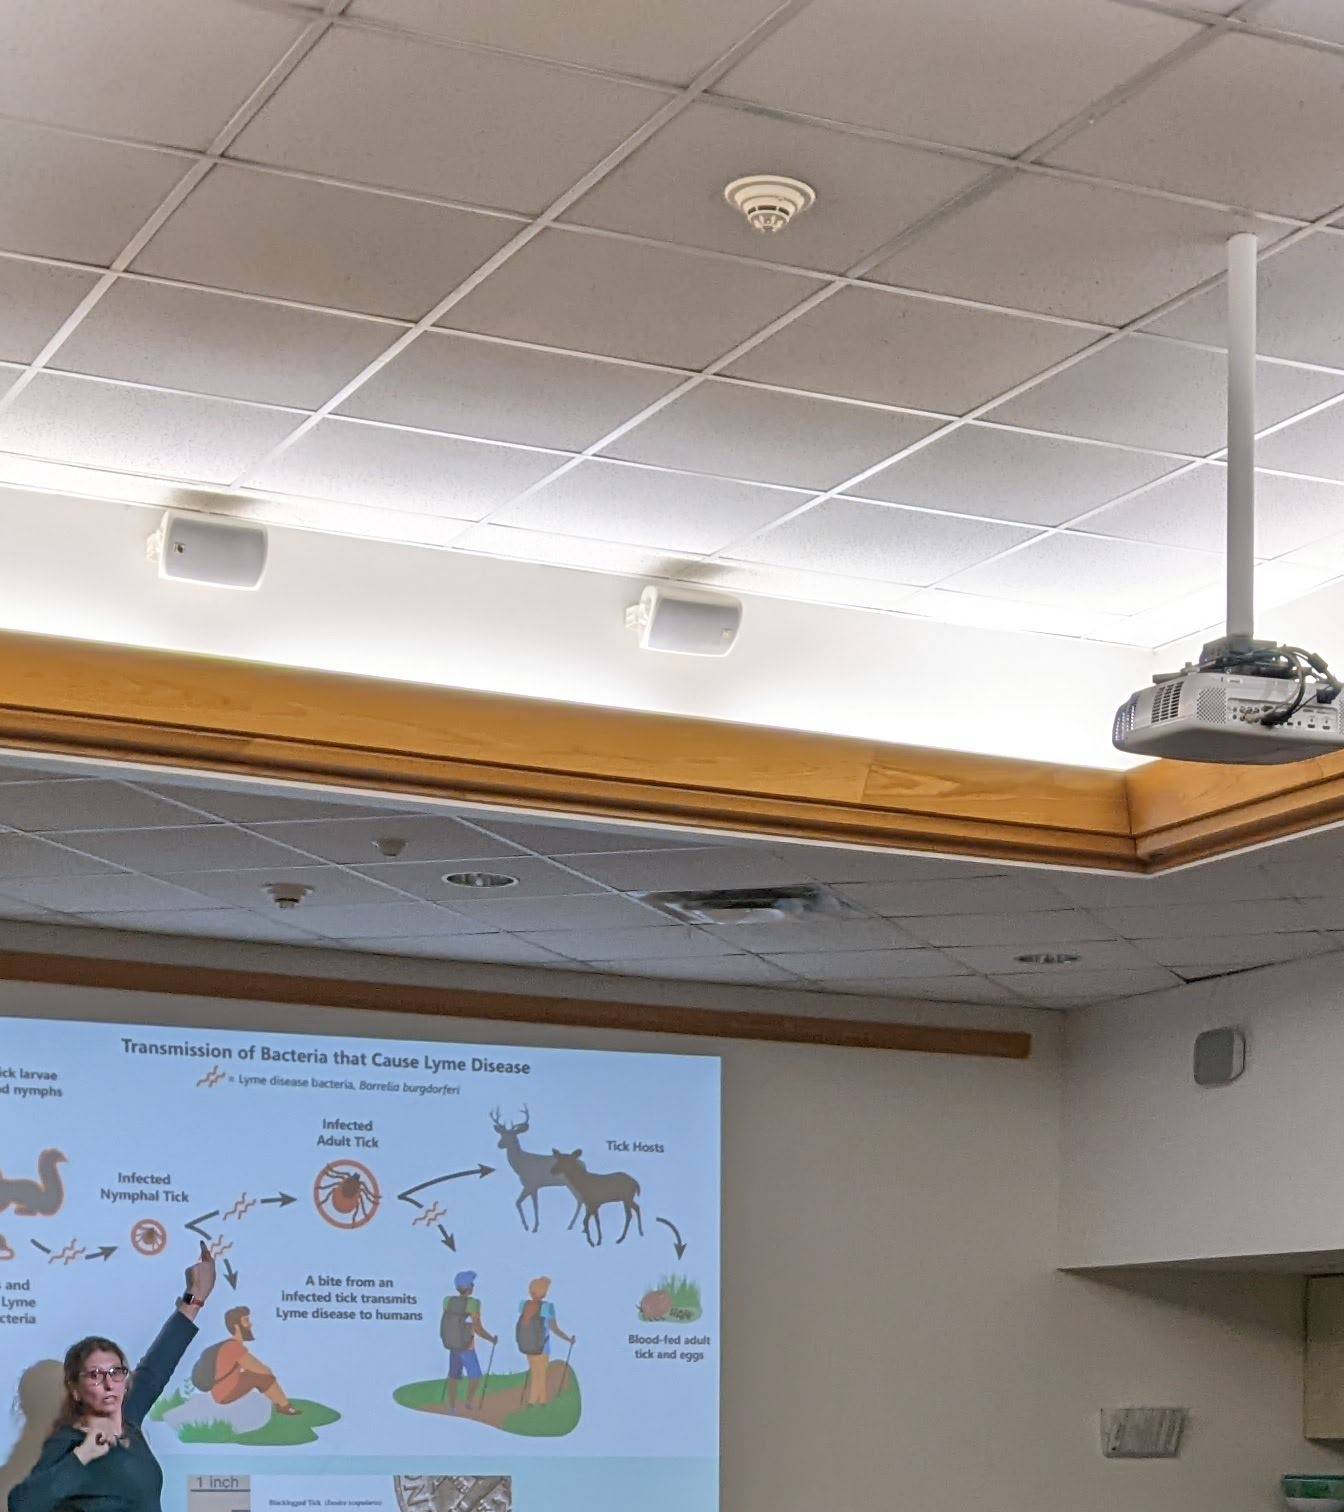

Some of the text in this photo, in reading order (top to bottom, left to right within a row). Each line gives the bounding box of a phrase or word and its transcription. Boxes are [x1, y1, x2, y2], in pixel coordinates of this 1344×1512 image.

[120, 1037, 531, 1075] Transmission of Bacteria that Cause Lyme Disease
[19, 1067, 58, 1082] larvae
[238, 1073, 267, 1087] Lyme
[269, 1075, 310, 1088] disease
[310, 1077, 356, 1091] bacteria,
[13, 1085, 63, 1099] nymphs
[322, 1118, 374, 1132] Infected
[316, 1134, 379, 1149] Adult Tick
[605, 1140, 665, 1154] Tick Hosts
[117, 1171, 171, 1186] Infected
[100, 1188, 190, 1204] Nymphal Tick
[4, 1278, 31, 1291] and
[305, 1274, 394, 1288] A bite from an
[1, 1295, 37, 1311] Lyme
[281, 1289, 418, 1305] infected tick transmits
[275, 1306, 424, 1322] Lyme disease to humans
[628, 1334, 711, 1346] Blood-fed adult
[634, 1348, 705, 1363] tick and eggs
[196, 1476, 240, 1489] 1 inch
